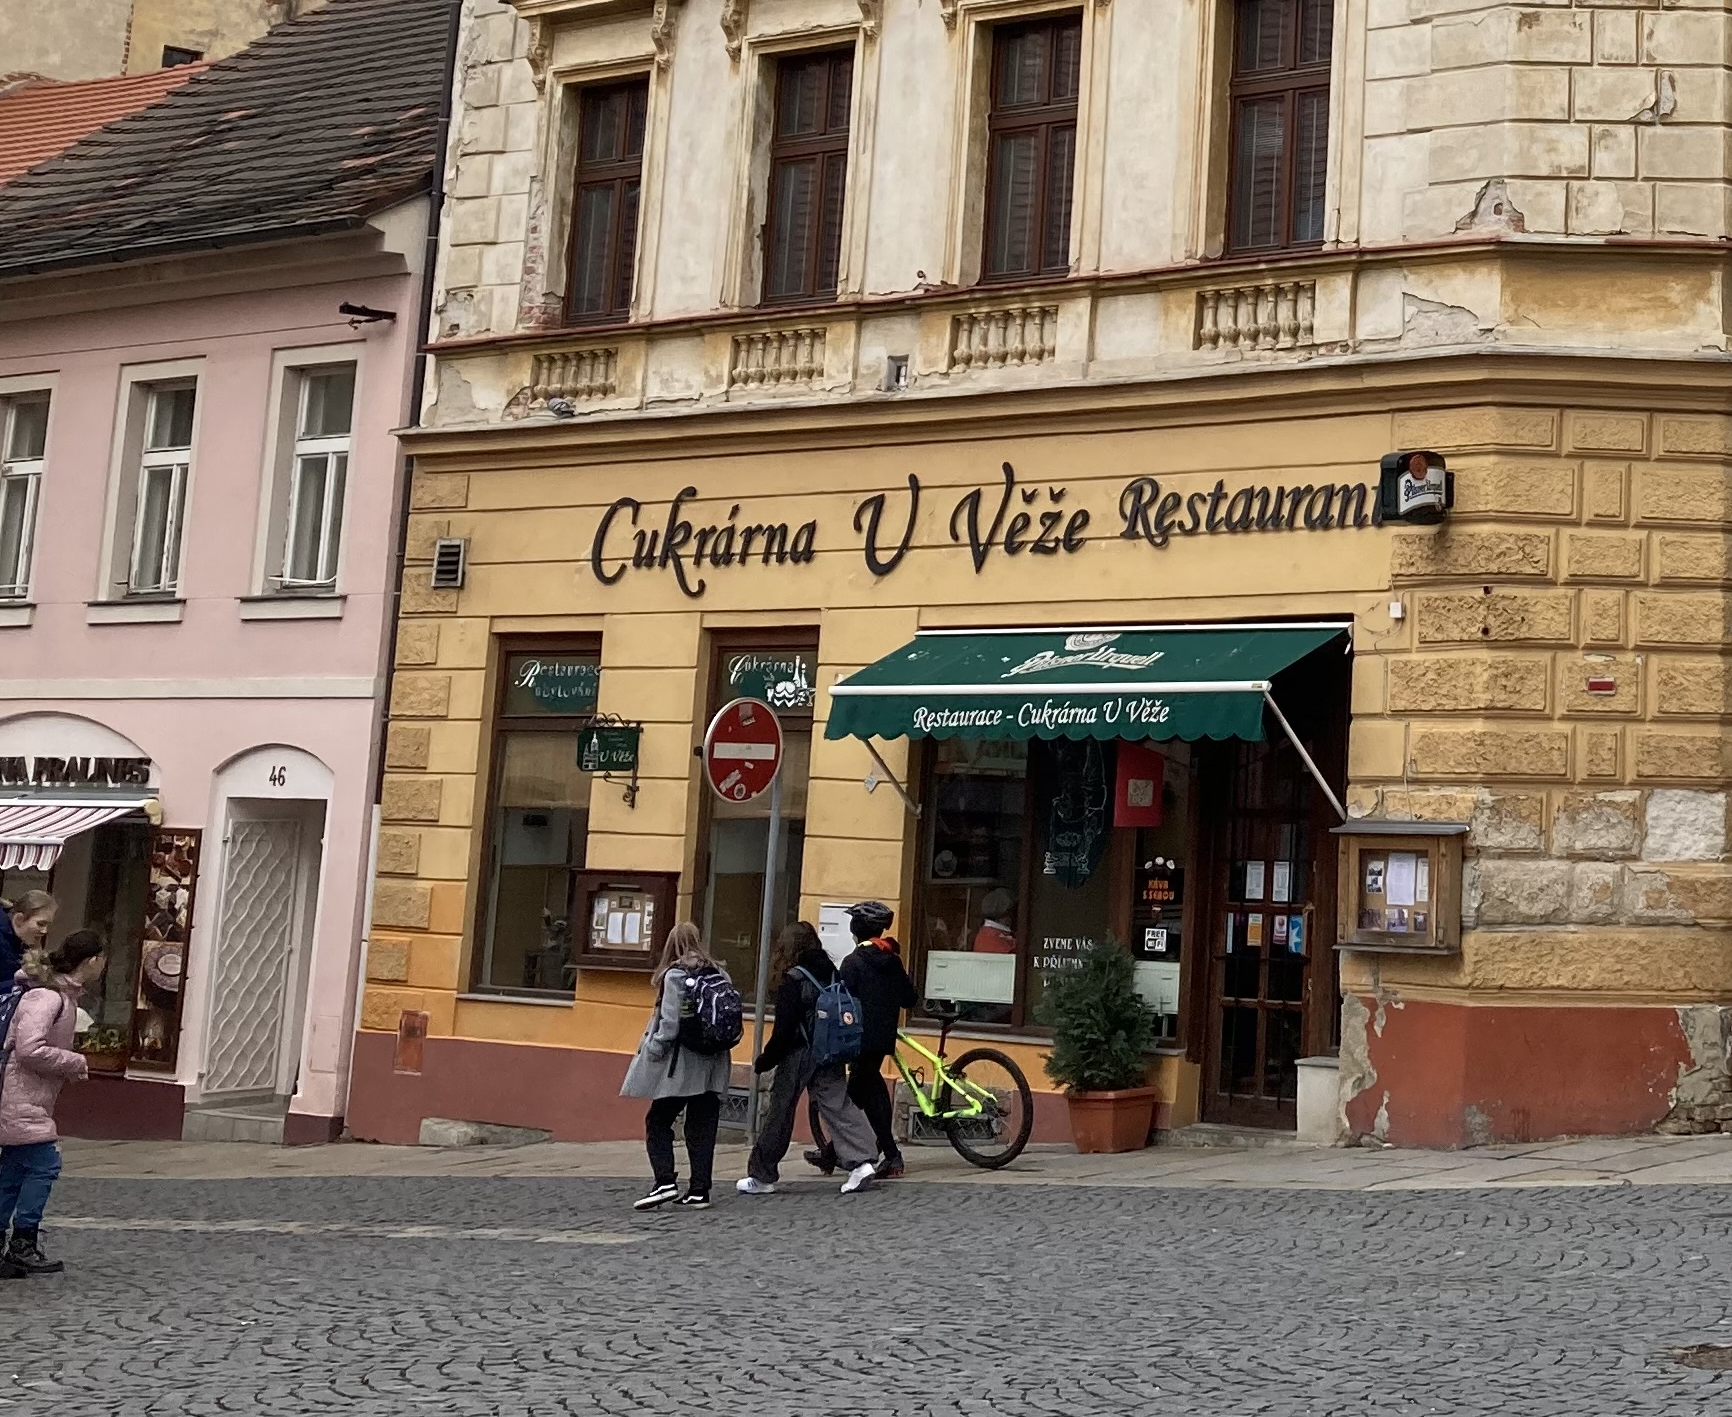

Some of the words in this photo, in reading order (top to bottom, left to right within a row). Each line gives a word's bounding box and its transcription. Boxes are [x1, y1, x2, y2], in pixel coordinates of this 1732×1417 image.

[592, 486, 817, 599] Cukrárna
[853, 473, 920, 577] U
[949, 461, 1091, 575] Věže
[913, 706, 1003, 732] Restaurace
[1017, 699, 1098, 731] Cukrárna
[1103, 698, 1123, 724] U
[1126, 697, 1171, 724] Věže
[269, 766, 286, 786] 46
[1043, 937, 1073, 950] ZVEME
[1033, 956, 1040, 968] K
